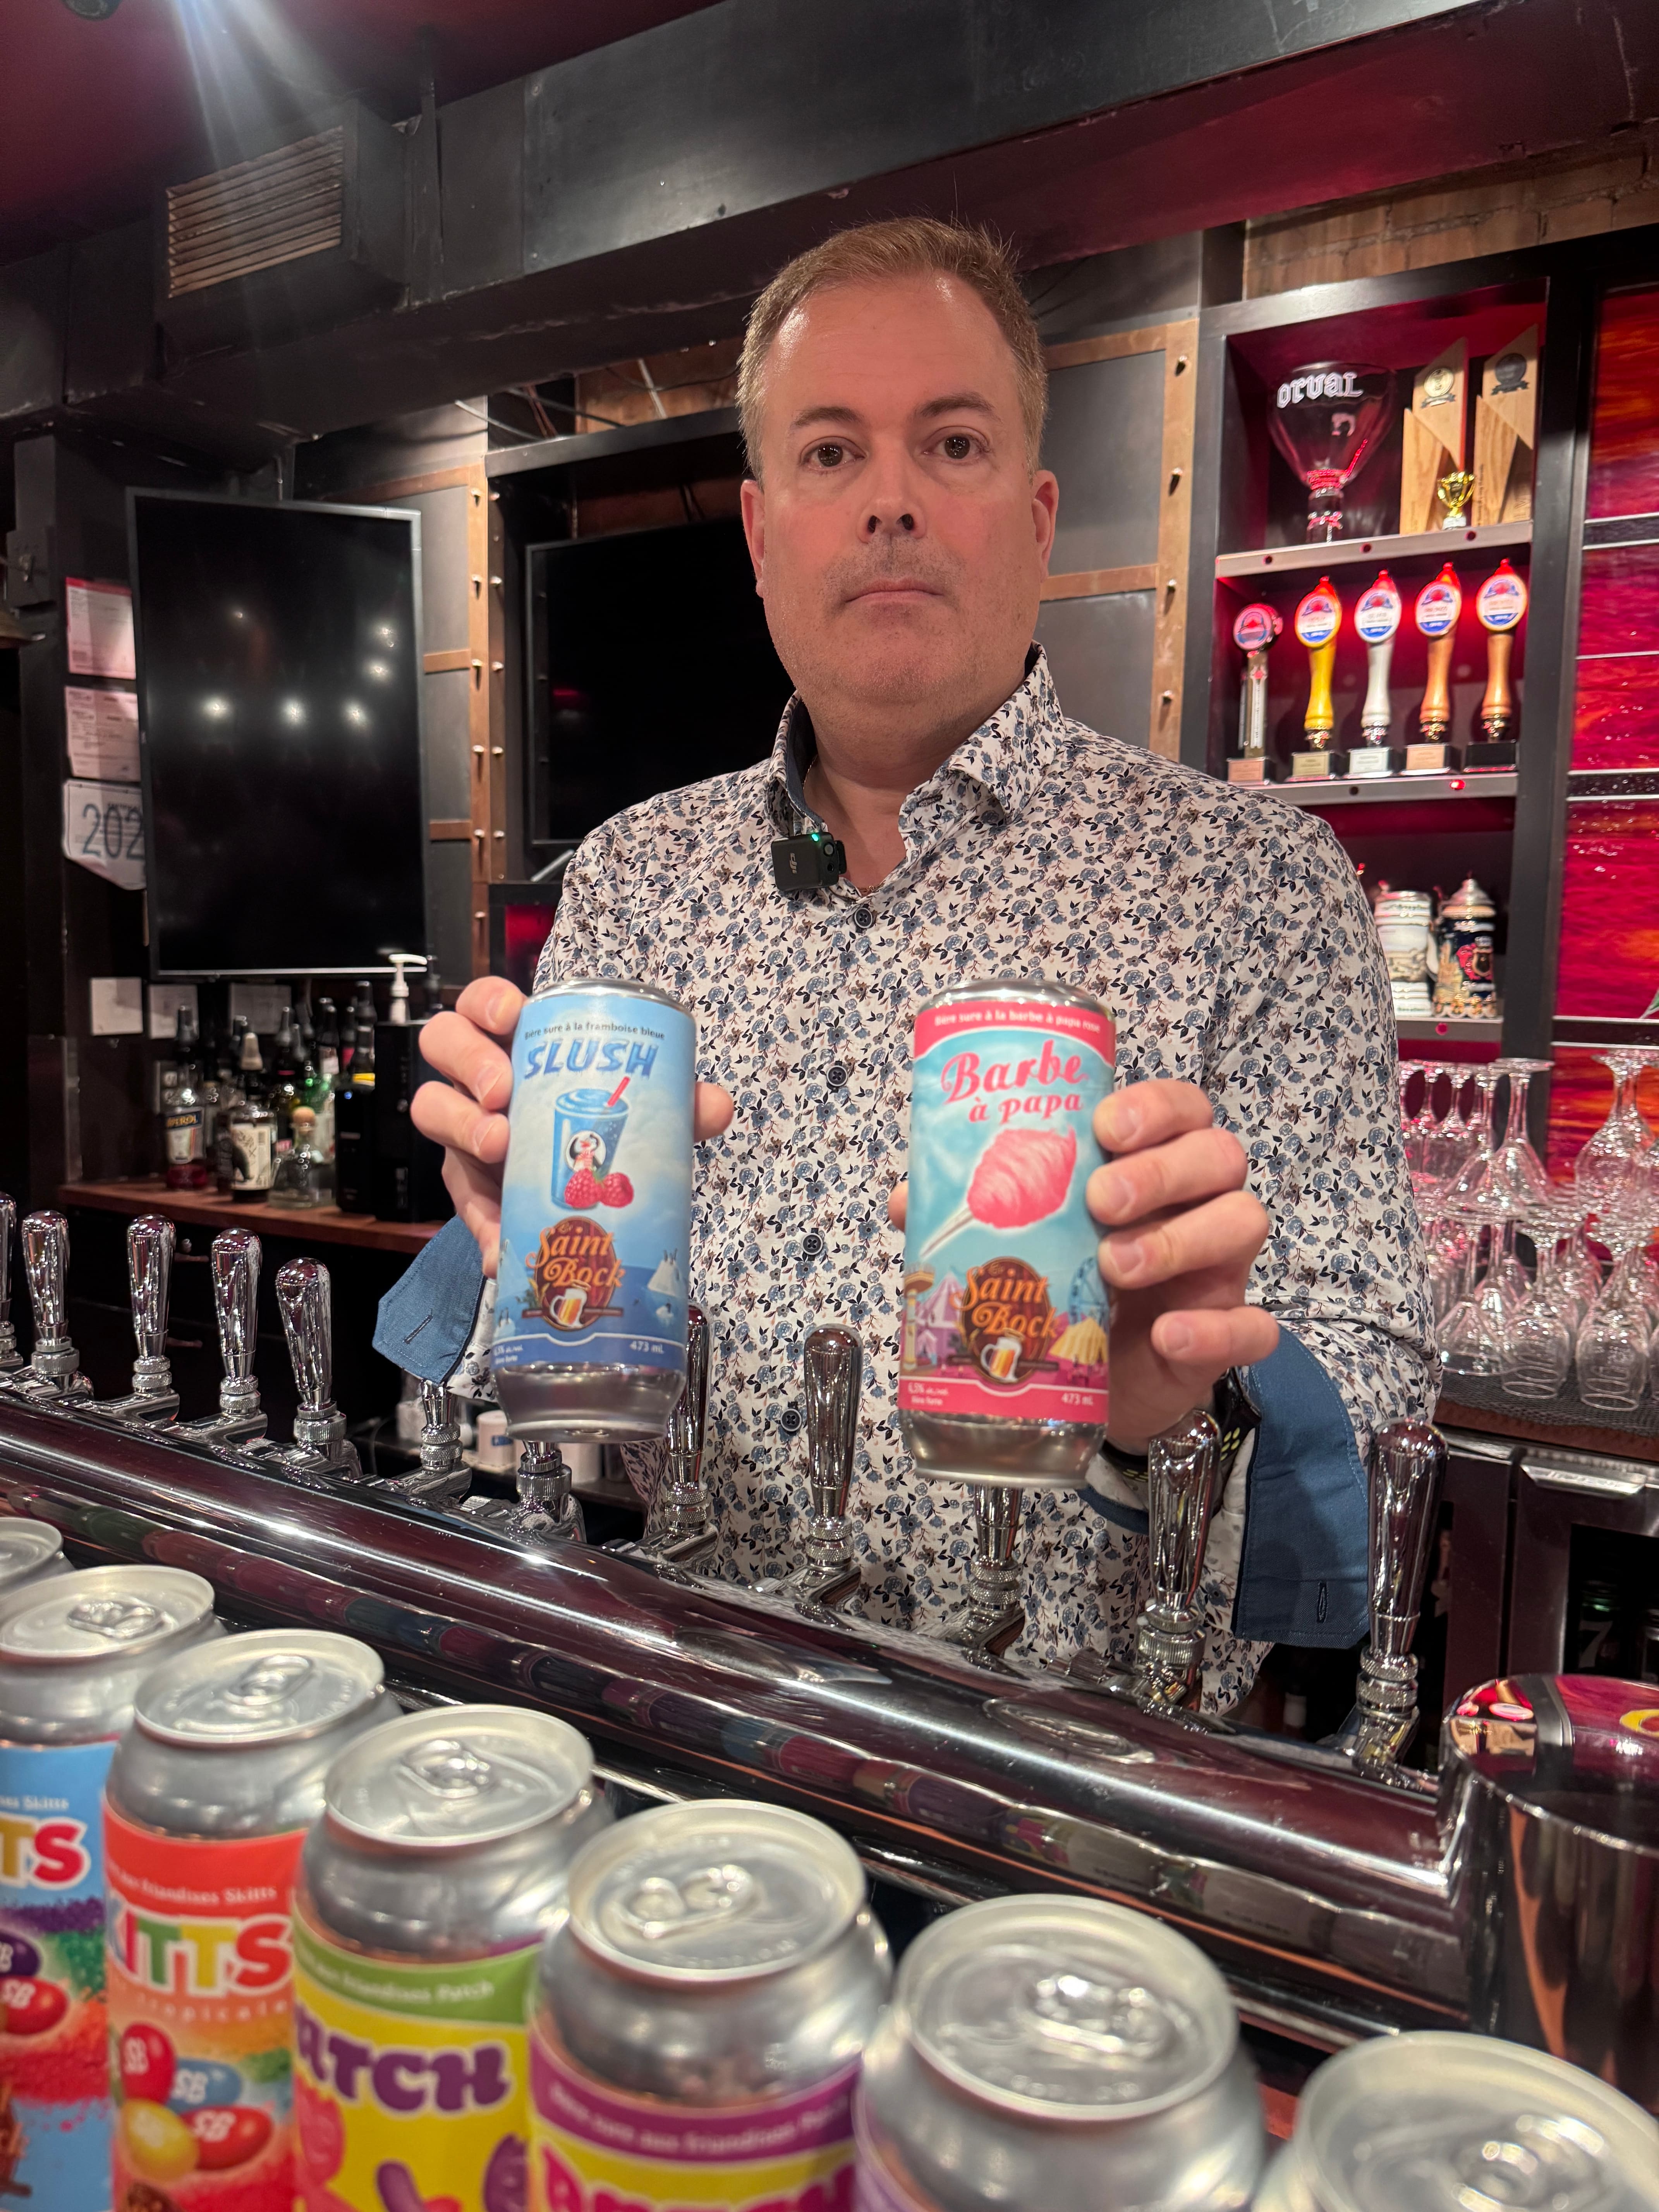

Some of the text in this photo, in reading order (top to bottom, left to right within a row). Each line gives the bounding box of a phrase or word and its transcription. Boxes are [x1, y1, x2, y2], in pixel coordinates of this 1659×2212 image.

[525, 1022, 665, 1041] Bière sure à la framboise bleue
[958, 1012, 982, 1023] sure
[985, 1010, 993, 1021] à
[995, 1010, 1006, 1021] la
[1009, 1010, 1044, 1023] barbe
[1046, 1013, 1054, 1024] à
[1056, 1015, 1081, 1029] papa
[524, 1037, 659, 1080] SLUSH
[941, 1039, 1089, 1106] Barbe
[969, 1094, 1083, 1125] à papa
[526, 1227, 615, 1269] Saint
[543, 1257, 626, 1288] Bock
[950, 1266, 1050, 1311] Saint
[971, 1301, 1058, 1338] Bock
[629, 1341, 649, 1352] 473
[1061, 1393, 1081, 1406] 473
